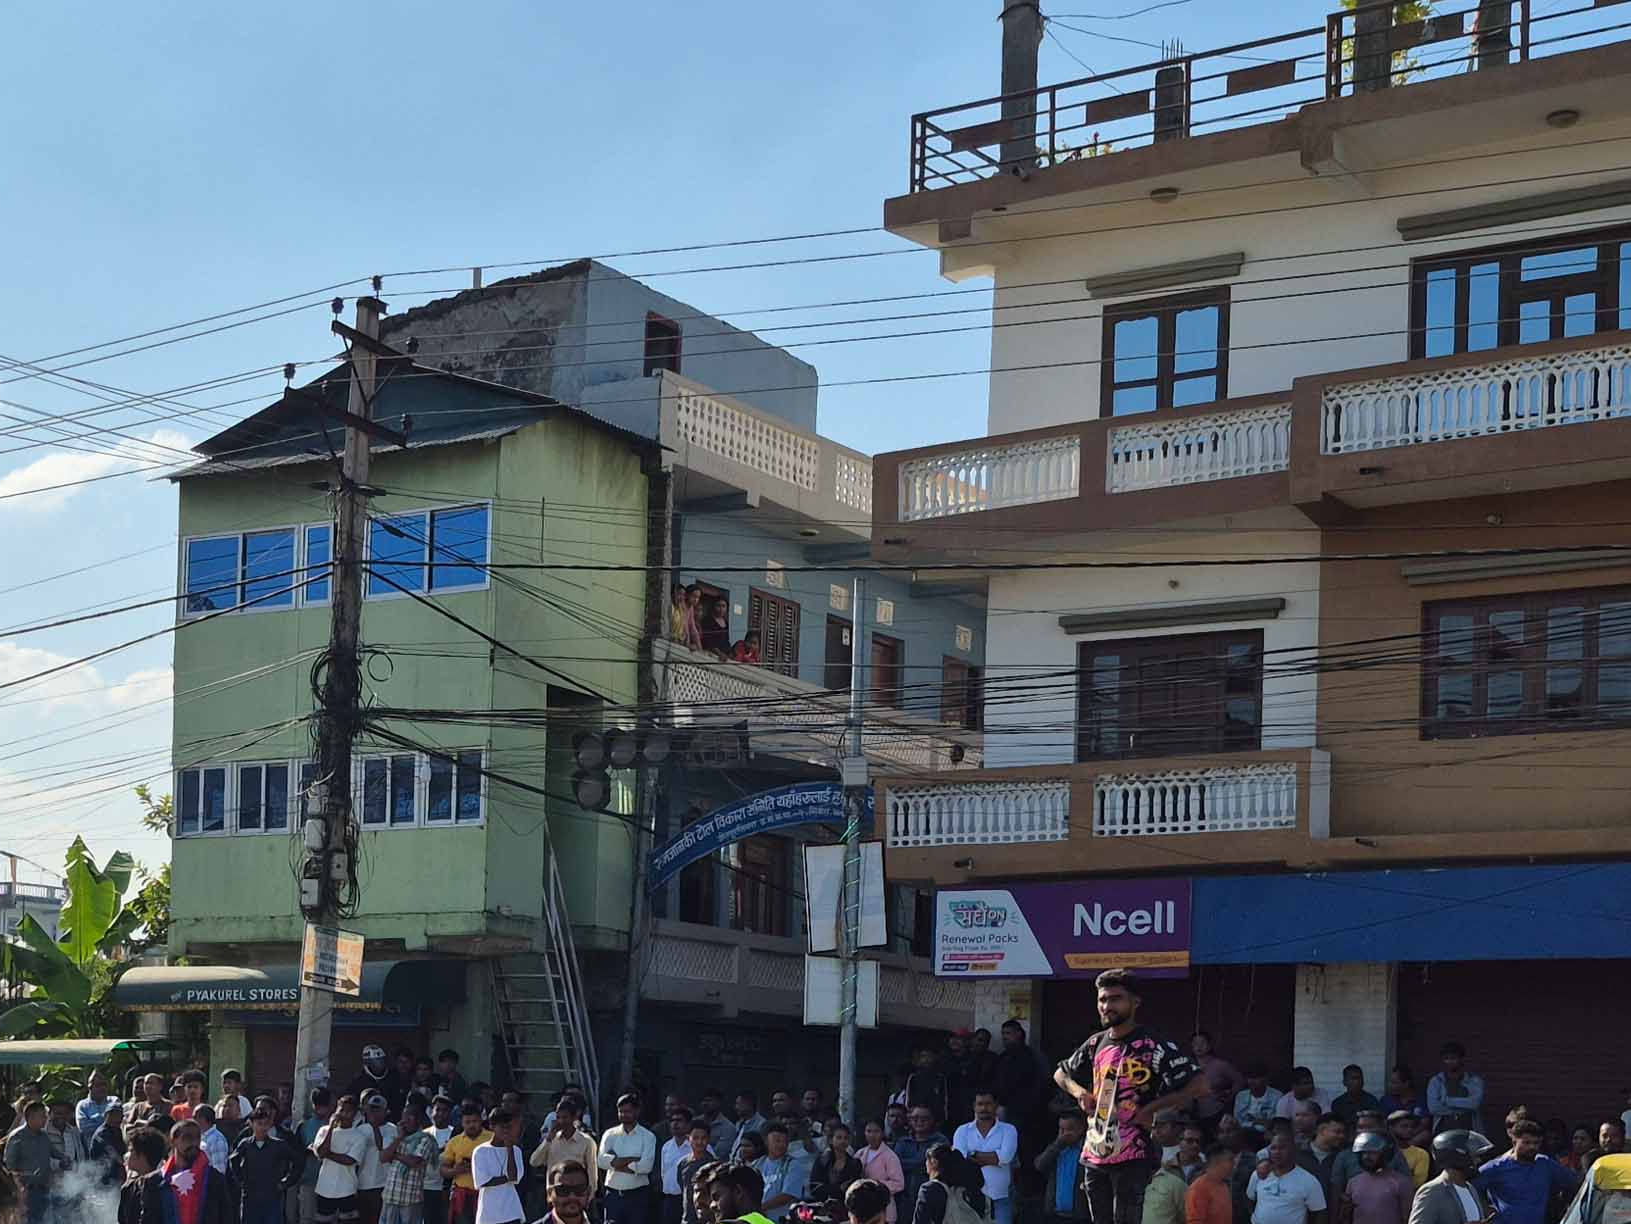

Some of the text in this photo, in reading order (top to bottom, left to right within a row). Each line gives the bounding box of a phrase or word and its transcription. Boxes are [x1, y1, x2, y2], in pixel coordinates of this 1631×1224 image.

[1073, 900, 1175, 936] Ncell
[942, 934, 1019, 944] Renewal Packs
[187, 990, 246, 1001] PYAKUREL
[249, 989, 298, 1000] STORES
